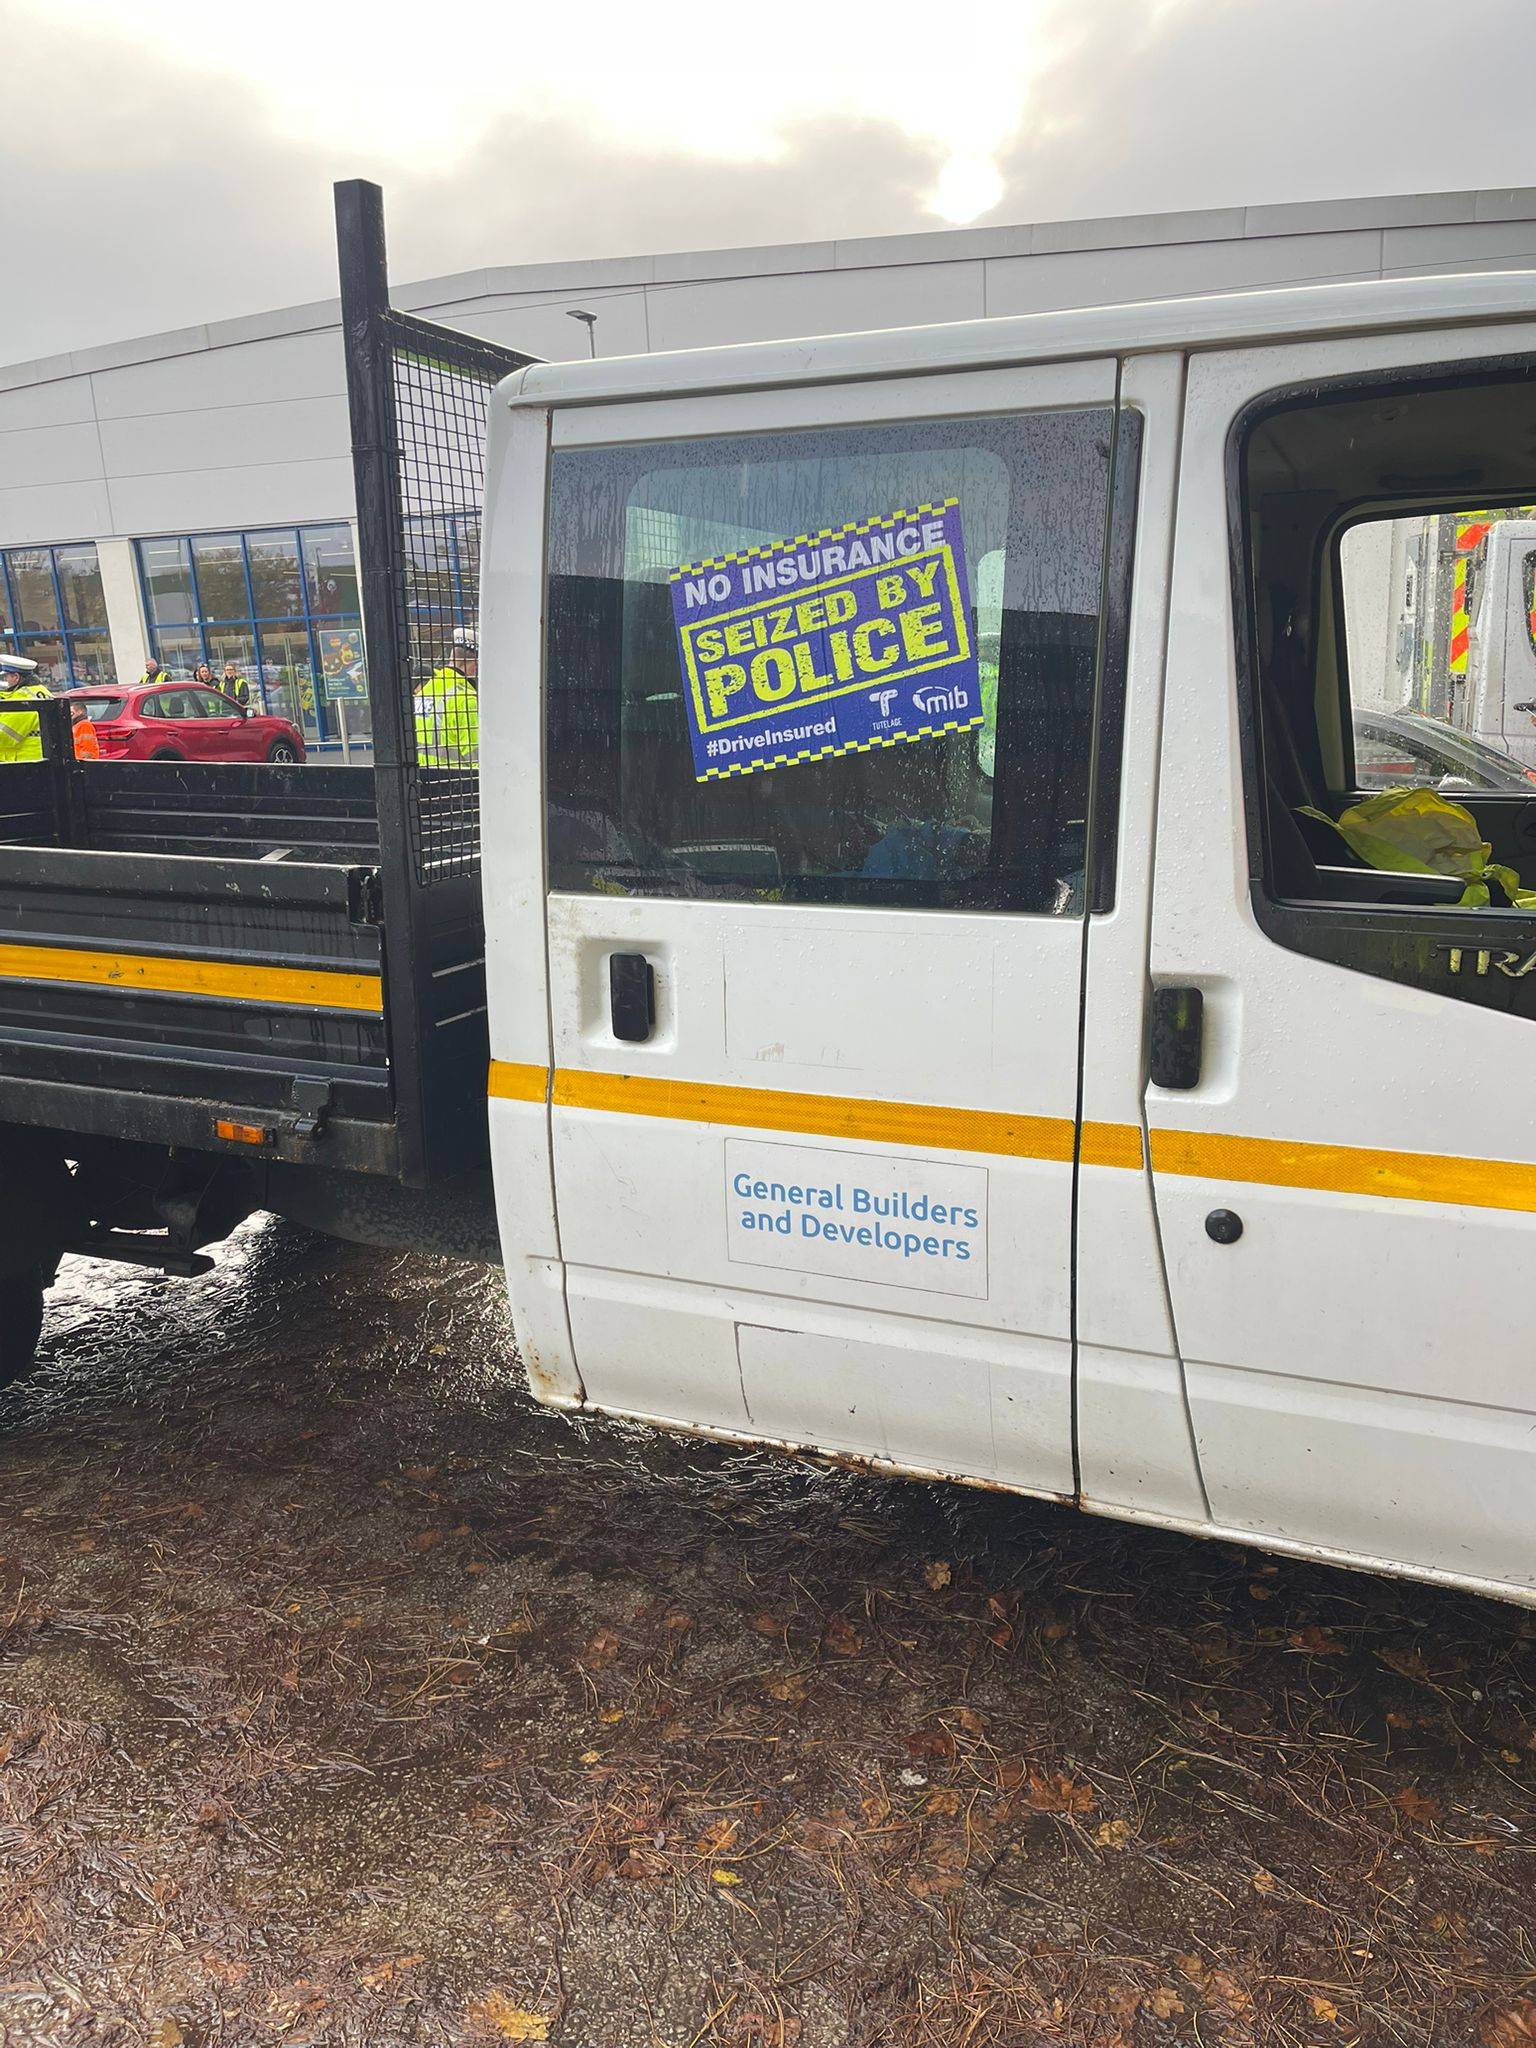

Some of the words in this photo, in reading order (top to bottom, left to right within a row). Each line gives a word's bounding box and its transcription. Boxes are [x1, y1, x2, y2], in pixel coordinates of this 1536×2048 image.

[685, 575, 731, 608] NO
[742, 520, 946, 594] INSURANCE
[696, 591, 857, 663] SEIZED
[876, 561, 940, 610] BY
[704, 602, 949, 717] POLICE
[706, 717, 837, 757] #DriveInsured
[872, 717, 903, 731] TUTELAGE
[733, 1173, 844, 1210] General
[853, 1188, 978, 1228] Builders
[741, 1210, 791, 1235] and
[802, 1214, 971, 1260] Developers
